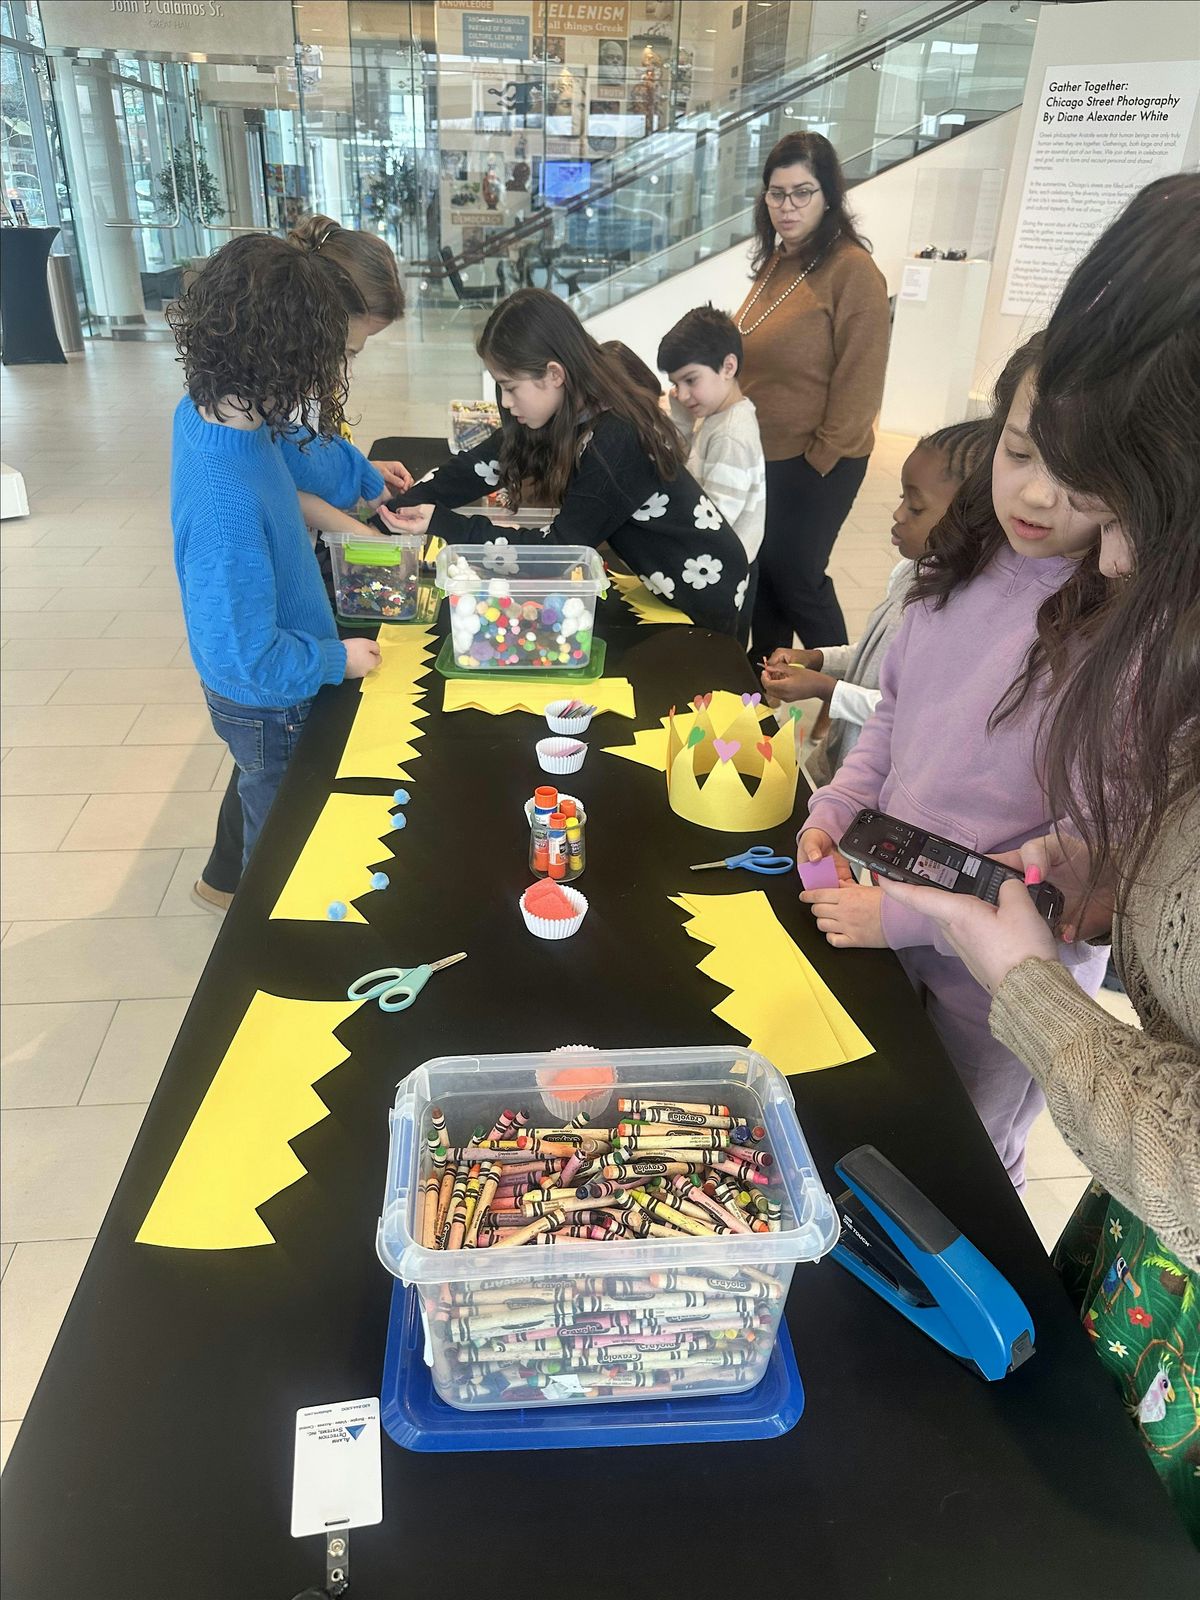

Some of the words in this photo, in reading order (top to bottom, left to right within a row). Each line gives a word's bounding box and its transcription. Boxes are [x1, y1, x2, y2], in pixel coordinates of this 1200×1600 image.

[110, 0, 139, 12] John
[143, 0, 152, 13] P.
[157, 0, 206, 16] Calamos
[209, 1, 224, 17] Sr.
[441, 0, 492, 9] KNOWLEDGE
[564, 21, 593, 33] things
[595, 22, 624, 33] Greek
[1049, 81, 1081, 92] Gather
[1084, 80, 1128, 94] Together:
[1046, 97, 1083, 109] Chicago
[1087, 96, 1114, 107] Street
[1117, 94, 1180, 108] Photography
[1043, 112, 1054, 124] By
[1057, 112, 1084, 122] Diane
[1087, 111, 1137, 121] Alexander
[1140, 111, 1169, 121] White
[672, 1112, 705, 1125] Crayola
[636, 1163, 667, 1174] Crayola
[710, 1277, 747, 1289] Crayola
[560, 1324, 598, 1335] Crayola
[602, 1352, 641, 1361] Crayola
